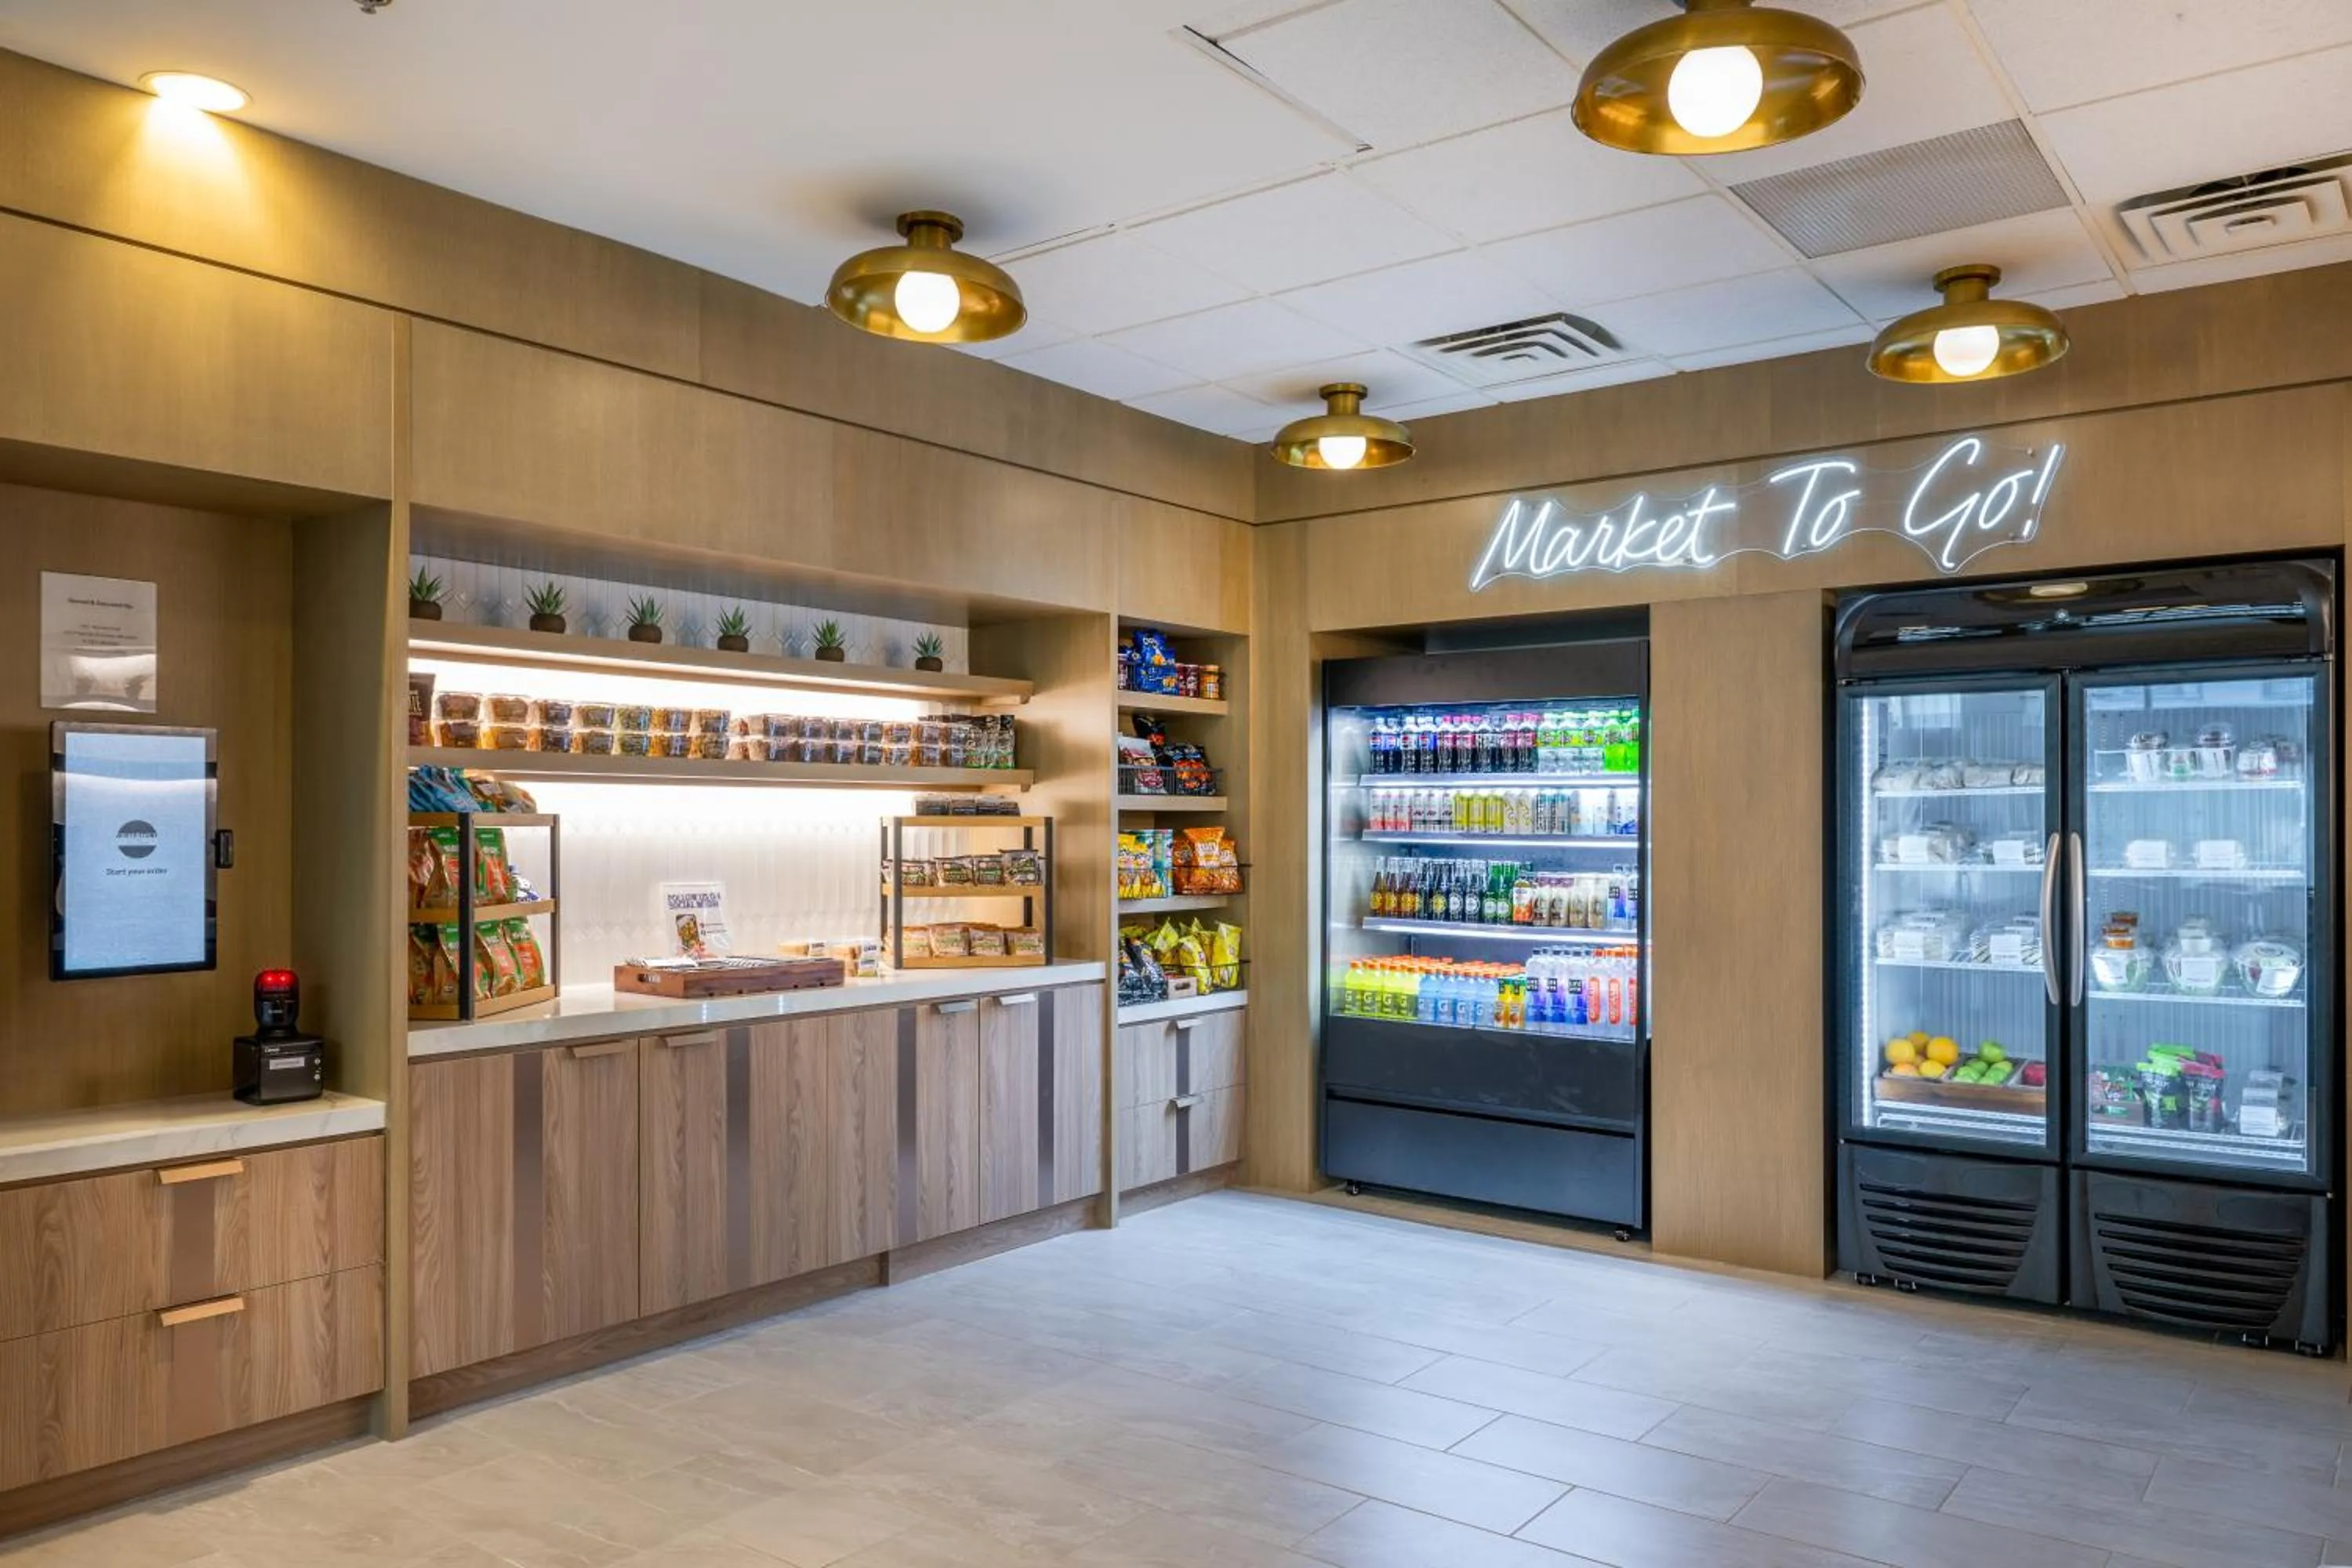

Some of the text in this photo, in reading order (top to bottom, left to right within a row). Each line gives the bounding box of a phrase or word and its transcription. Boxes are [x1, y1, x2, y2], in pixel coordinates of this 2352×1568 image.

[1470, 437, 2060, 590] Market To Go!
